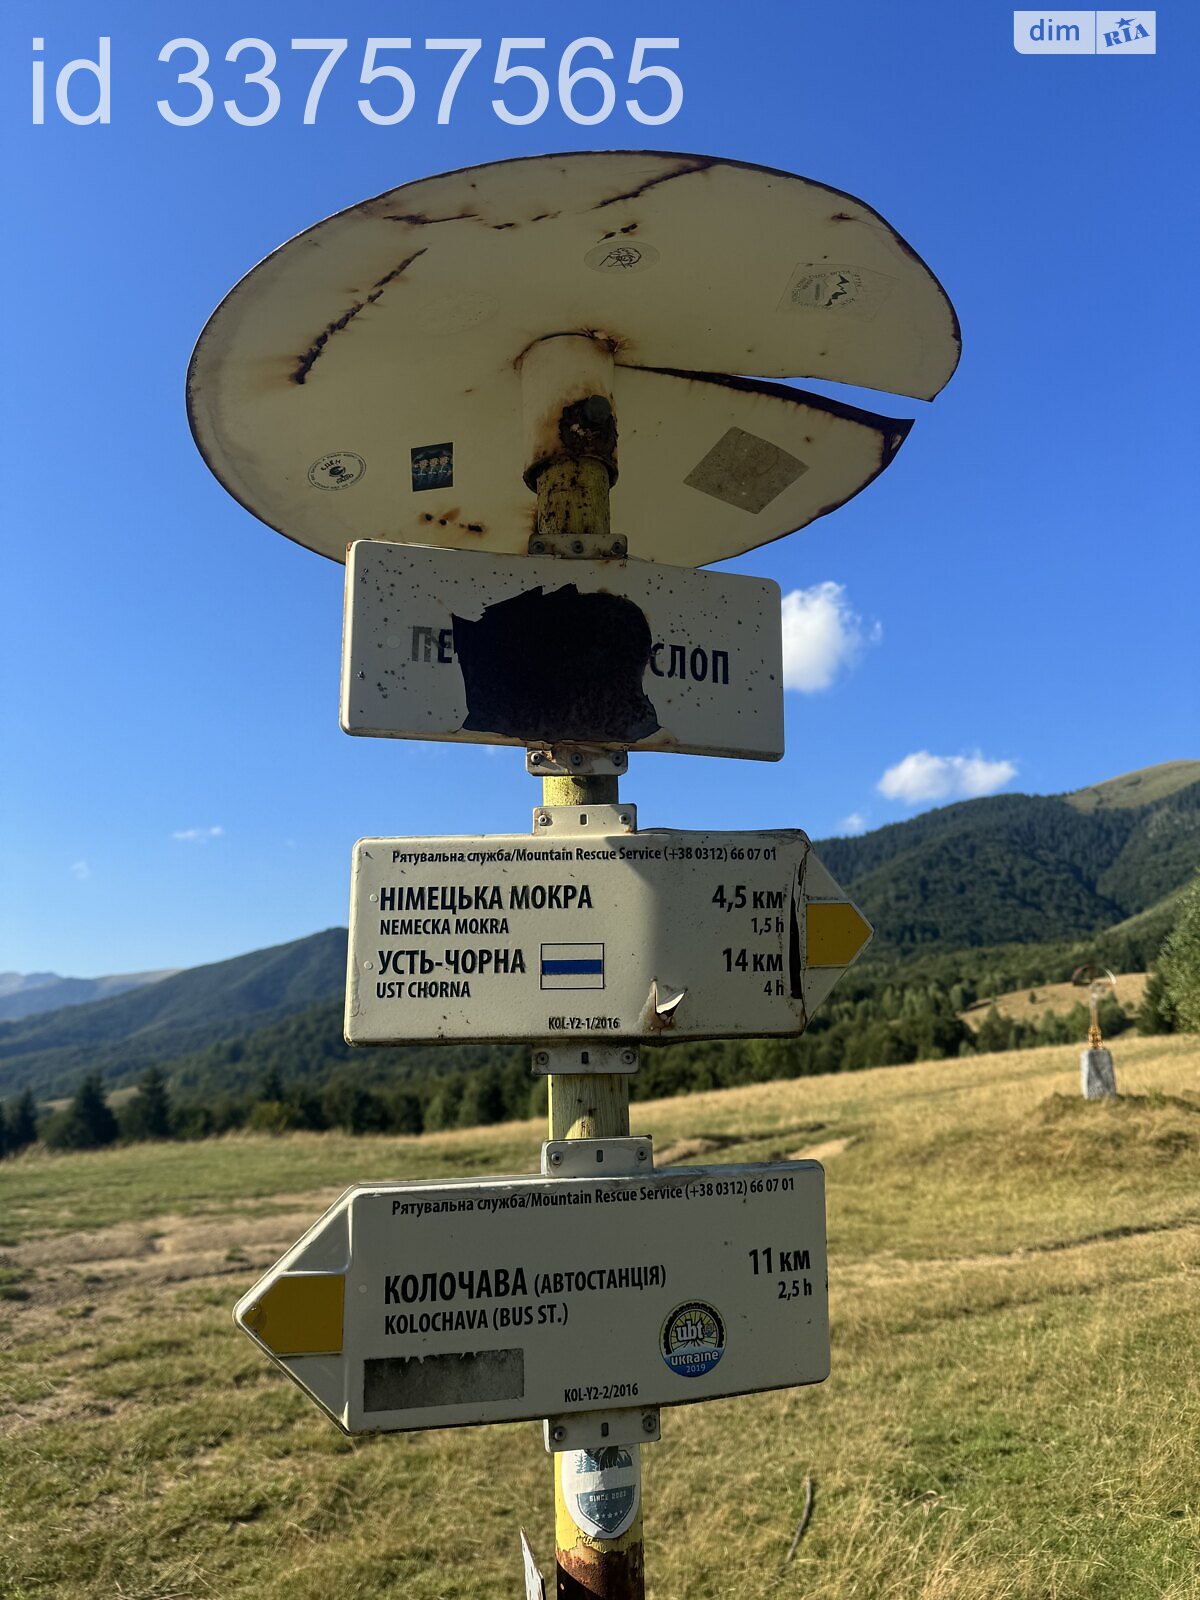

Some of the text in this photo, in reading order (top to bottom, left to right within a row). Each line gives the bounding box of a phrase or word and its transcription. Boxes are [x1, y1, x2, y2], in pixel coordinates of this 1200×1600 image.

[392, 850, 464, 866] Рятувальна
[575, 848, 616, 861] Rescue
[619, 848, 661, 861] Service
[663, 848, 693, 862] (+38
[695, 847, 728, 862] 0312)
[730, 848, 745, 861] 66
[747, 848, 761, 861] 07
[763, 848, 777, 861] 01
[380, 884, 593, 915] НІМЕЦЬКА МОКРА
[712, 884, 747, 913] 4,5
[380, 918, 509, 935] NEMECKA MOKRA
[751, 918, 785, 935] 1,5 h
[378, 949, 526, 975] УСТЬ-ЧОРНА
[722, 948, 748, 972] 14
[376, 981, 471, 998] UST CHORNA
[763, 980, 785, 996] 4 h
[548, 1017, 620, 1030] KOL-Y2-1/2016
[391, 1199, 474, 1217] Рятувальна
[595, 1188, 638, 1203] Rescue
[640, 1187, 683, 1200] Service
[685, 1184, 714, 1200] (+38
[715, 1181, 748, 1197] 0312)
[749, 1180, 764, 1193] 66
[766, 1179, 780, 1192] 07
[781, 1177, 795, 1191] 01
[748, 1247, 773, 1275] 11
[384, 1265, 667, 1305] КОЛОЧАВА (АВТОСТАНЦІЯ)
[778, 1278, 813, 1300] 2,5 h
[384, 1302, 569, 1336] KOLOCHAVA (BUS ST.)
[686, 1363, 706, 1374] 2019
[564, 1383, 638, 1403] KOL-Y2-2/2016
